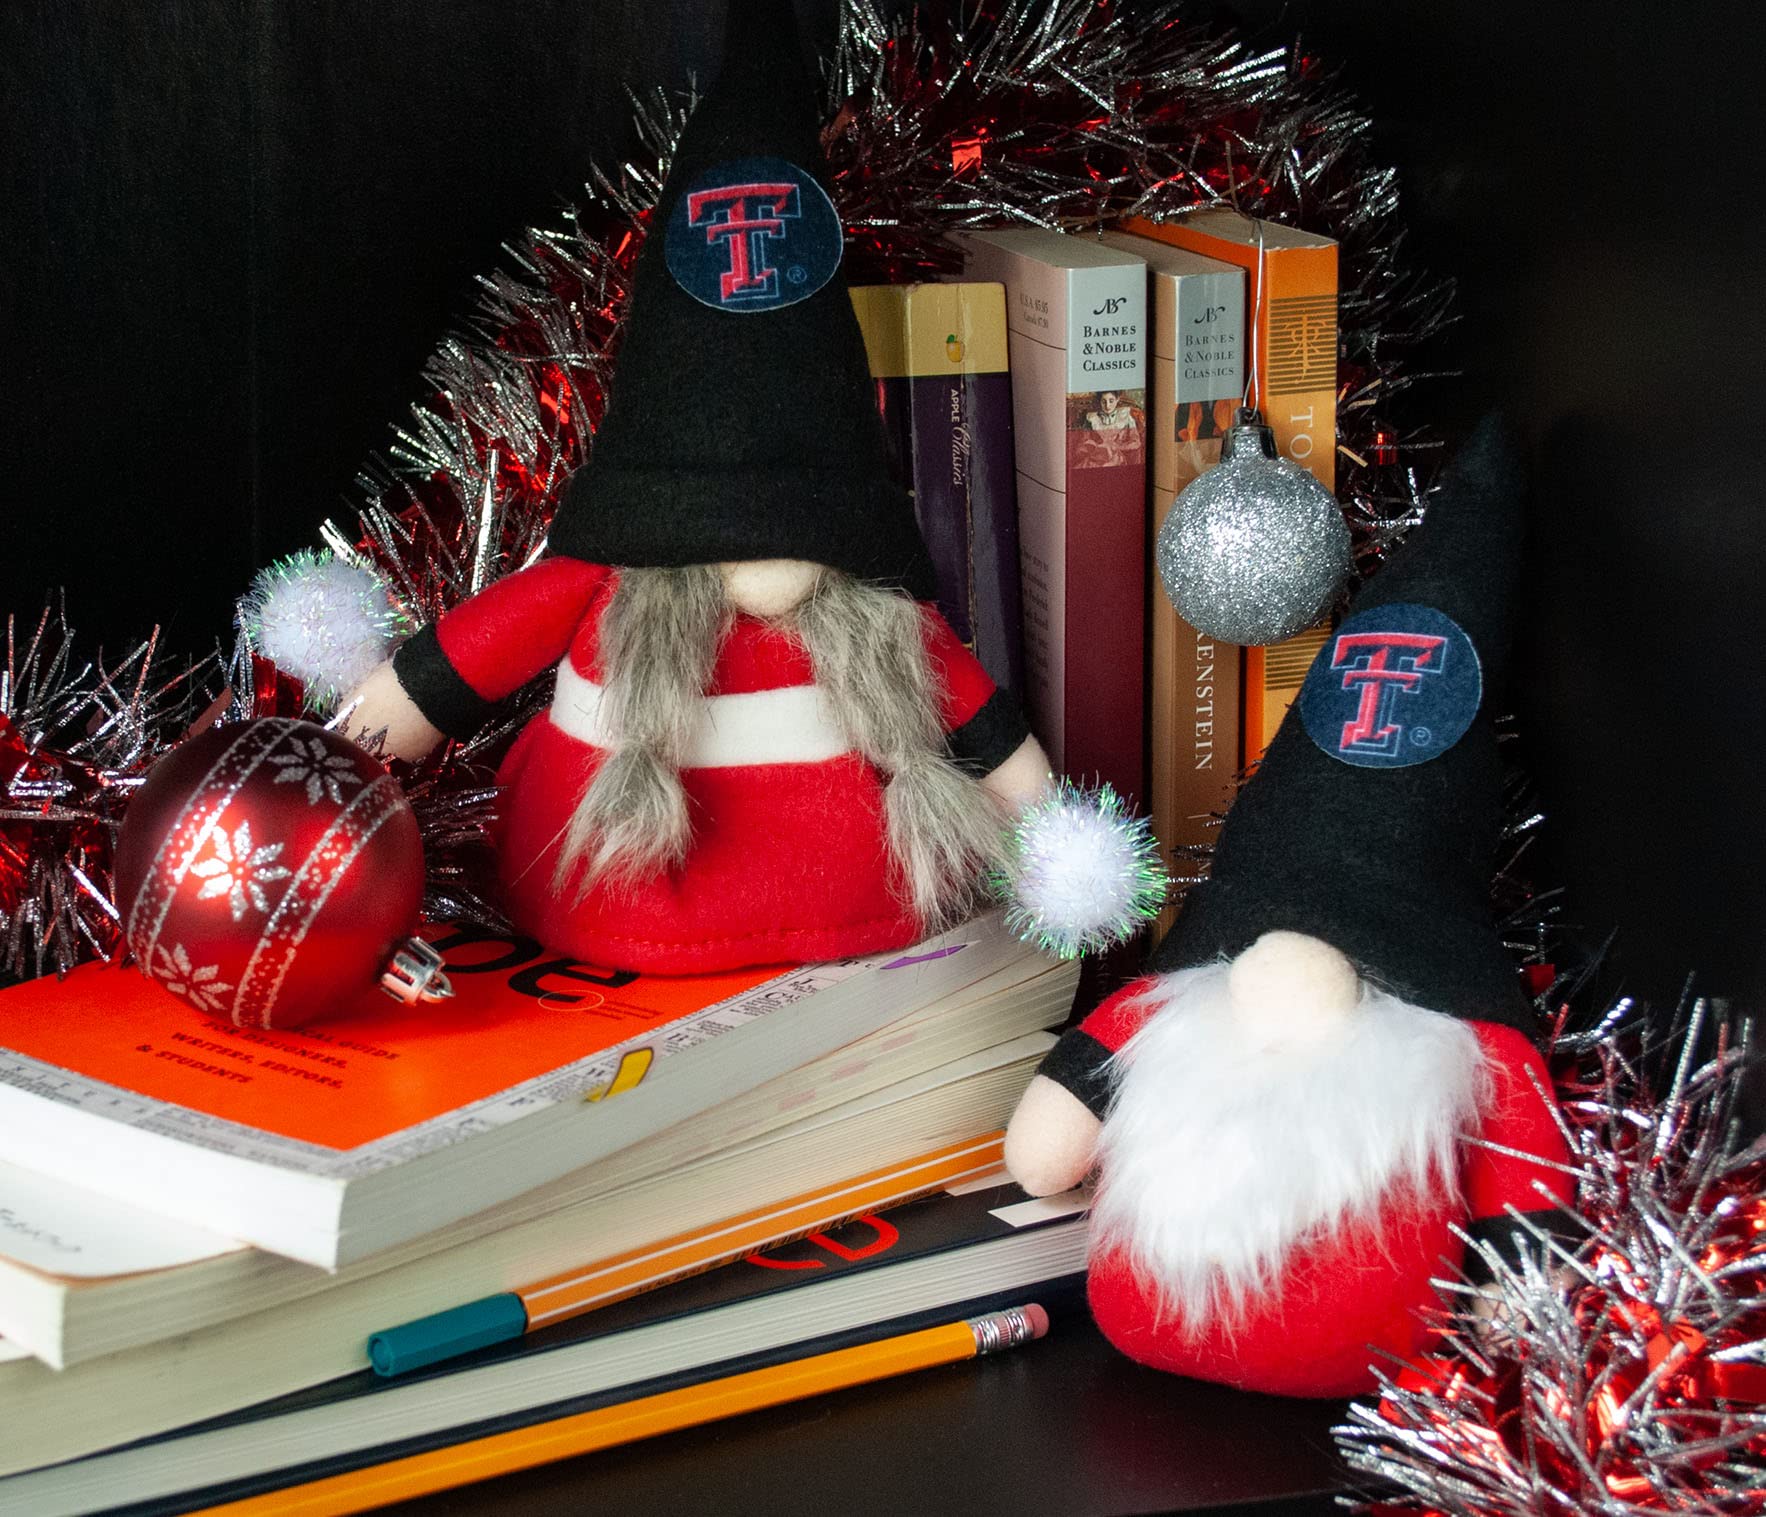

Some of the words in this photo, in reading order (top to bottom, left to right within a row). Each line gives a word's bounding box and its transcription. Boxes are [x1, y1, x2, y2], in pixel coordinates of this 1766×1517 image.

[1083, 325, 1136, 338] BARNES
[1185, 334, 1235, 346] BARNES
[1083, 359, 1136, 372] CLASSICS
[1184, 367, 1234, 379] CLASSICS
[951, 389, 960, 423] APPLE
[155, 1051, 253, 1083] STUDENTS
